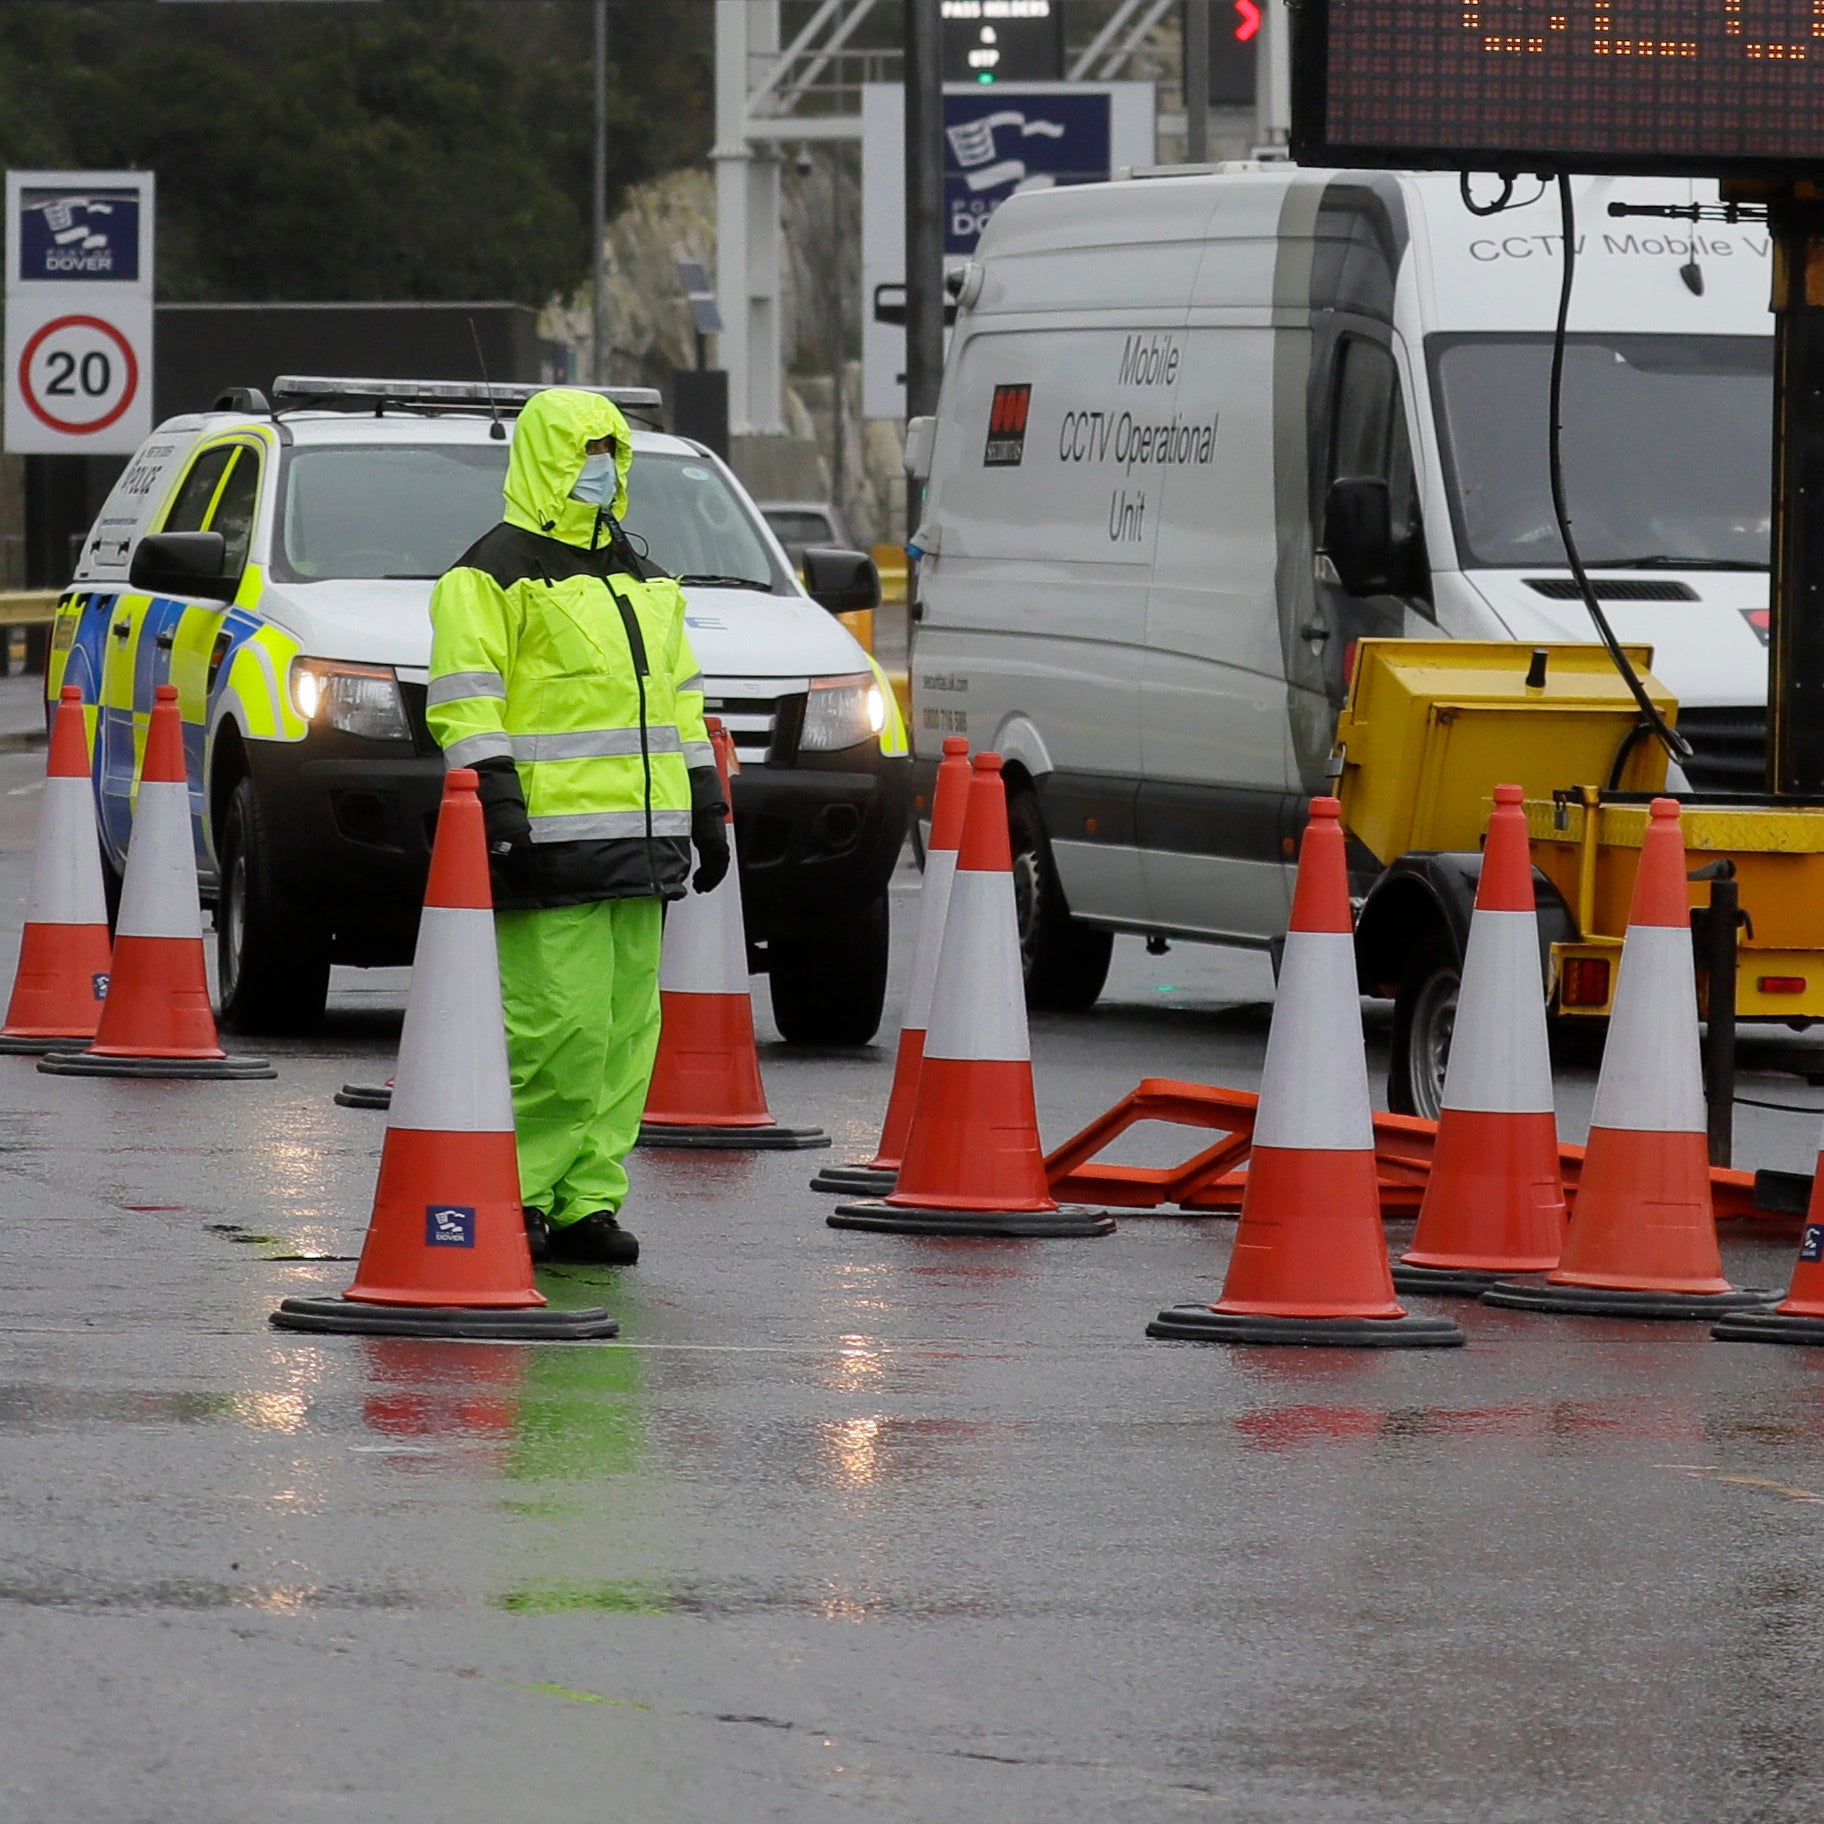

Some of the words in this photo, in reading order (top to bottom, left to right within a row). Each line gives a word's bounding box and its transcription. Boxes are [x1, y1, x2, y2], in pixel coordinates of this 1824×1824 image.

[46, 257, 113, 271] DOVER
[1468, 234, 1586, 263] CCTV
[1603, 233, 1734, 258] Mobile
[45, 351, 111, 397] 20
[1117, 334, 1180, 387] Mobile
[1058, 411, 1115, 463] CCTV
[1114, 411, 1220, 477] Operational
[1108, 489, 1146, 543] Unit
